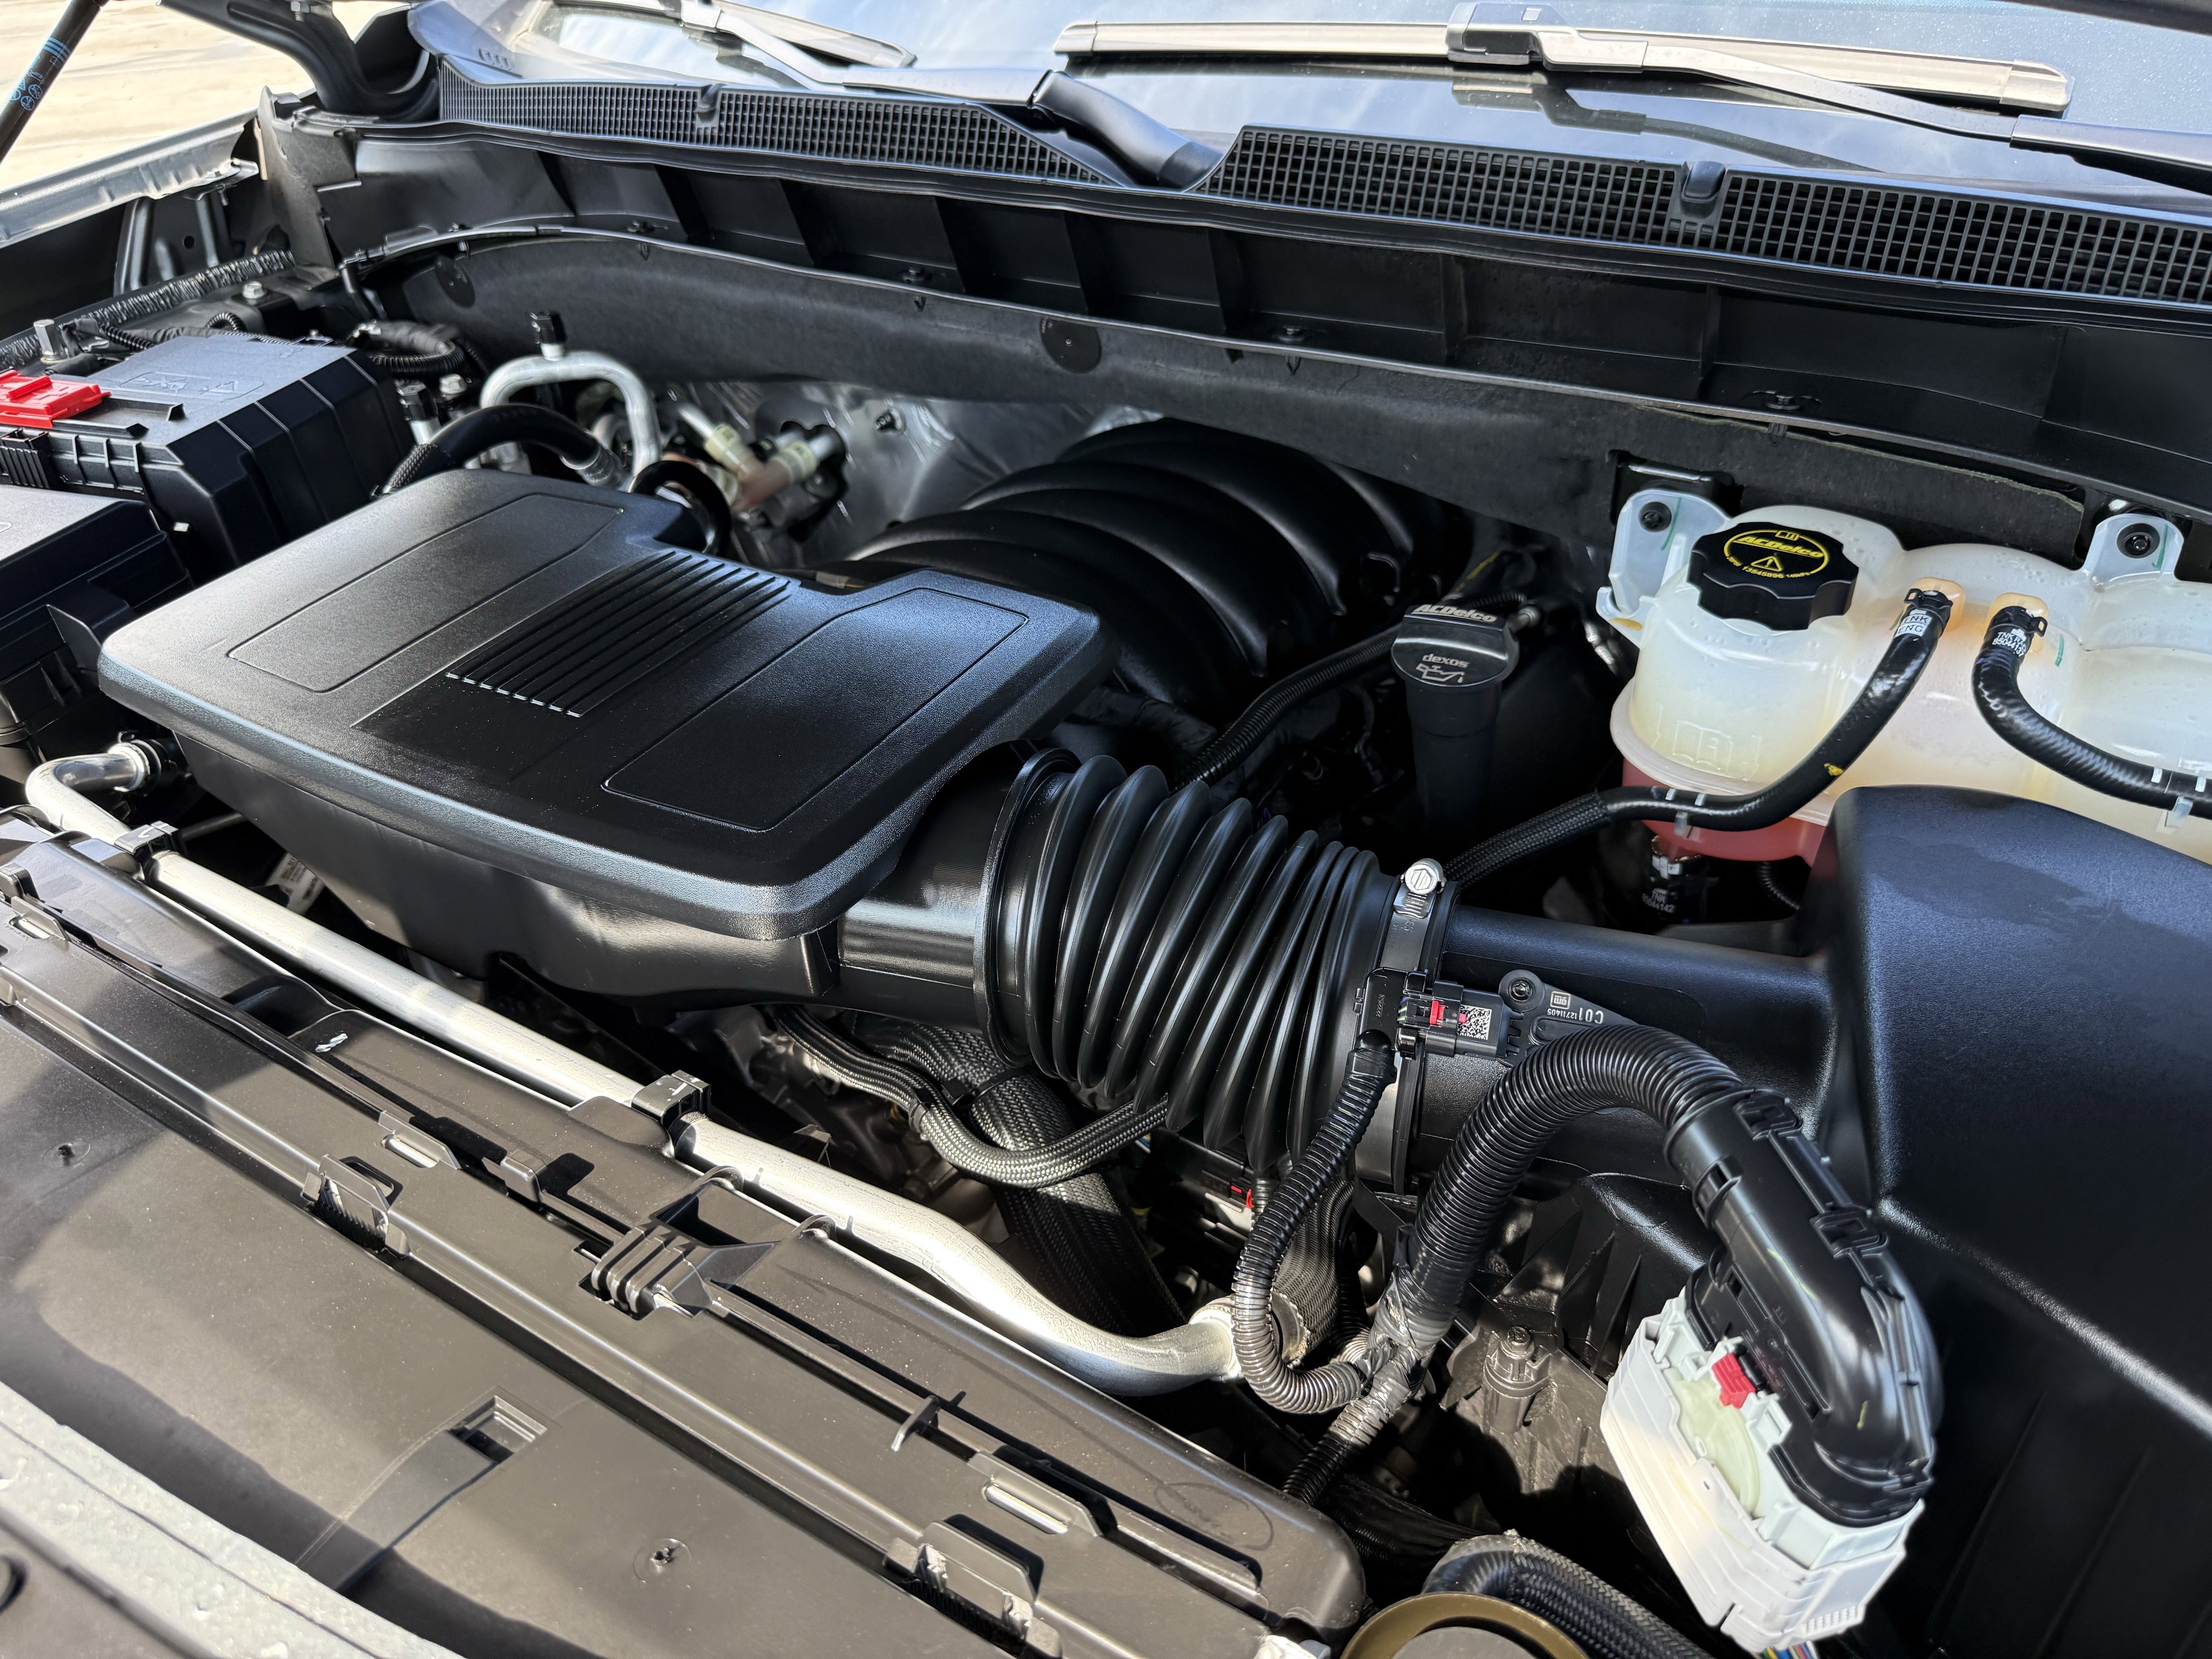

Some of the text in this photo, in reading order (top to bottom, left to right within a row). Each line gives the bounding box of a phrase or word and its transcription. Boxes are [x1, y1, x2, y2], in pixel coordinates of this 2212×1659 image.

[1736, 536, 1824, 558] ACDelco
[1413, 604, 1498, 623] ACDelco
[1898, 624, 1923, 633] ENG
[1997, 632, 2013, 643] TNK
[1992, 638, 2026, 657] 85044137
[1422, 653, 1470, 668] dexos
